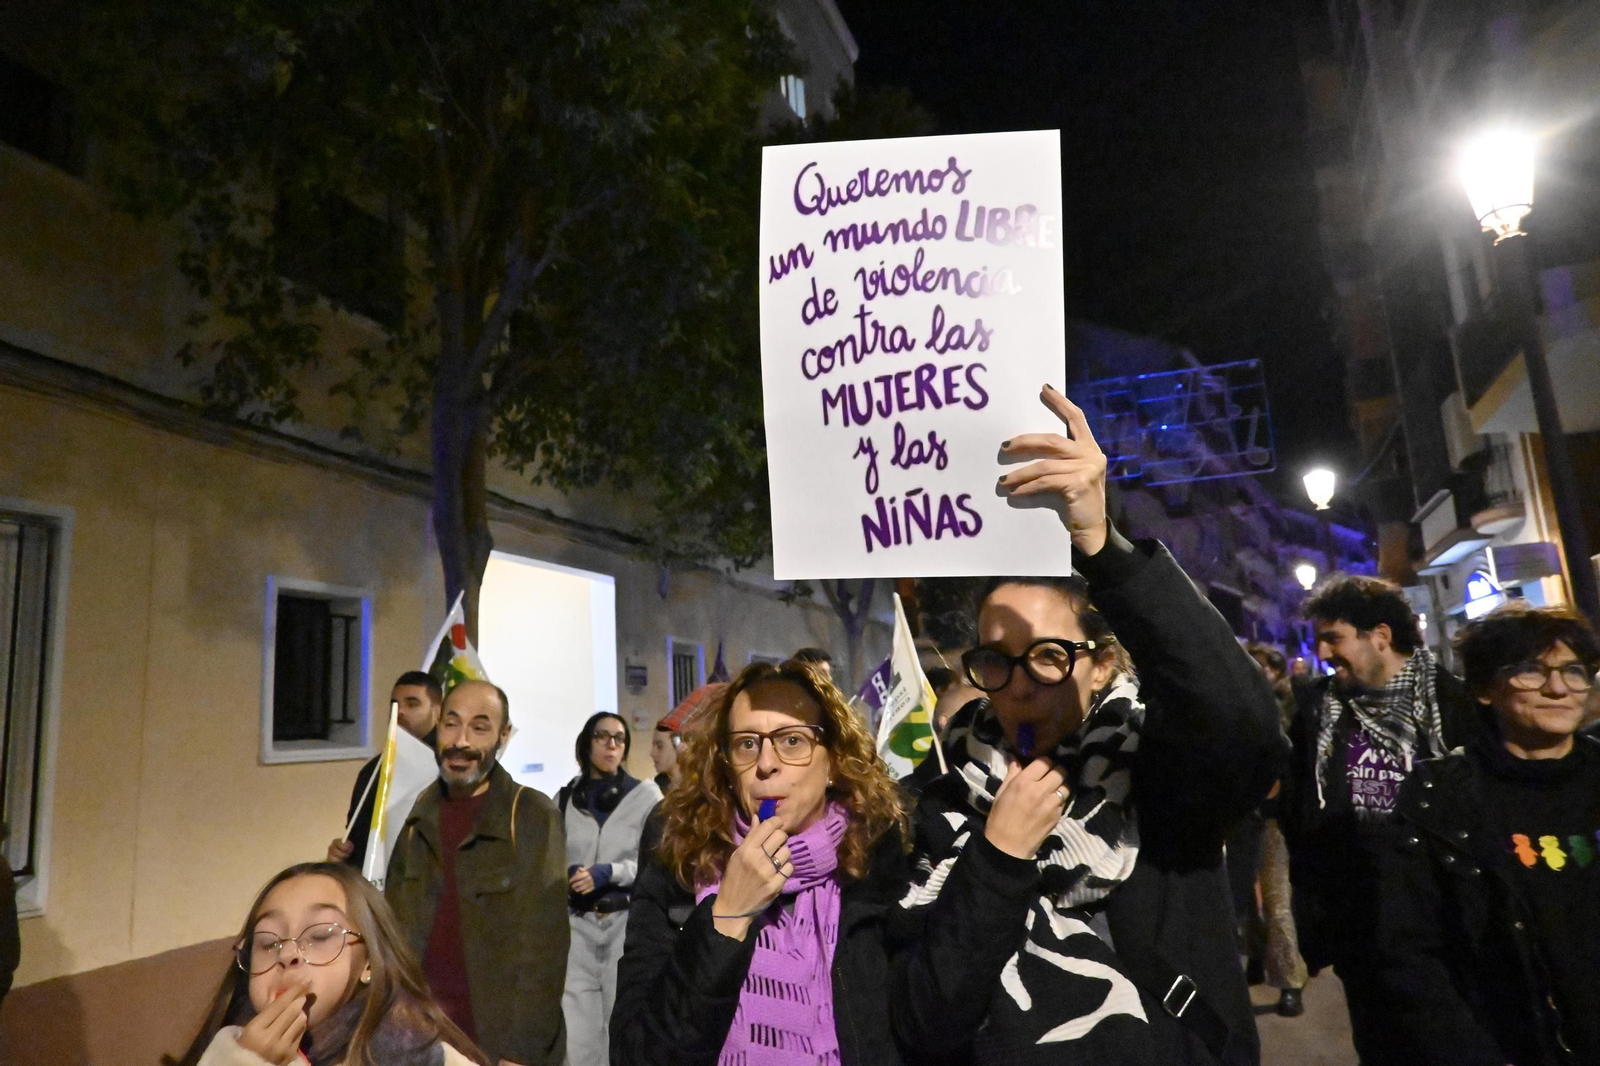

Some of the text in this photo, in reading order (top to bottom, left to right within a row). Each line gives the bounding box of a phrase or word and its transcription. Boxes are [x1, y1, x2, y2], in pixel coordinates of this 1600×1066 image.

[793, 156, 972, 216] Queremos
[769, 199, 1056, 284] un mundo LIBRE
[801, 246, 1022, 327] de violencia
[800, 303, 994, 381] contra las
[820, 362, 989, 428] MUJERES
[852, 420, 950, 495] y las
